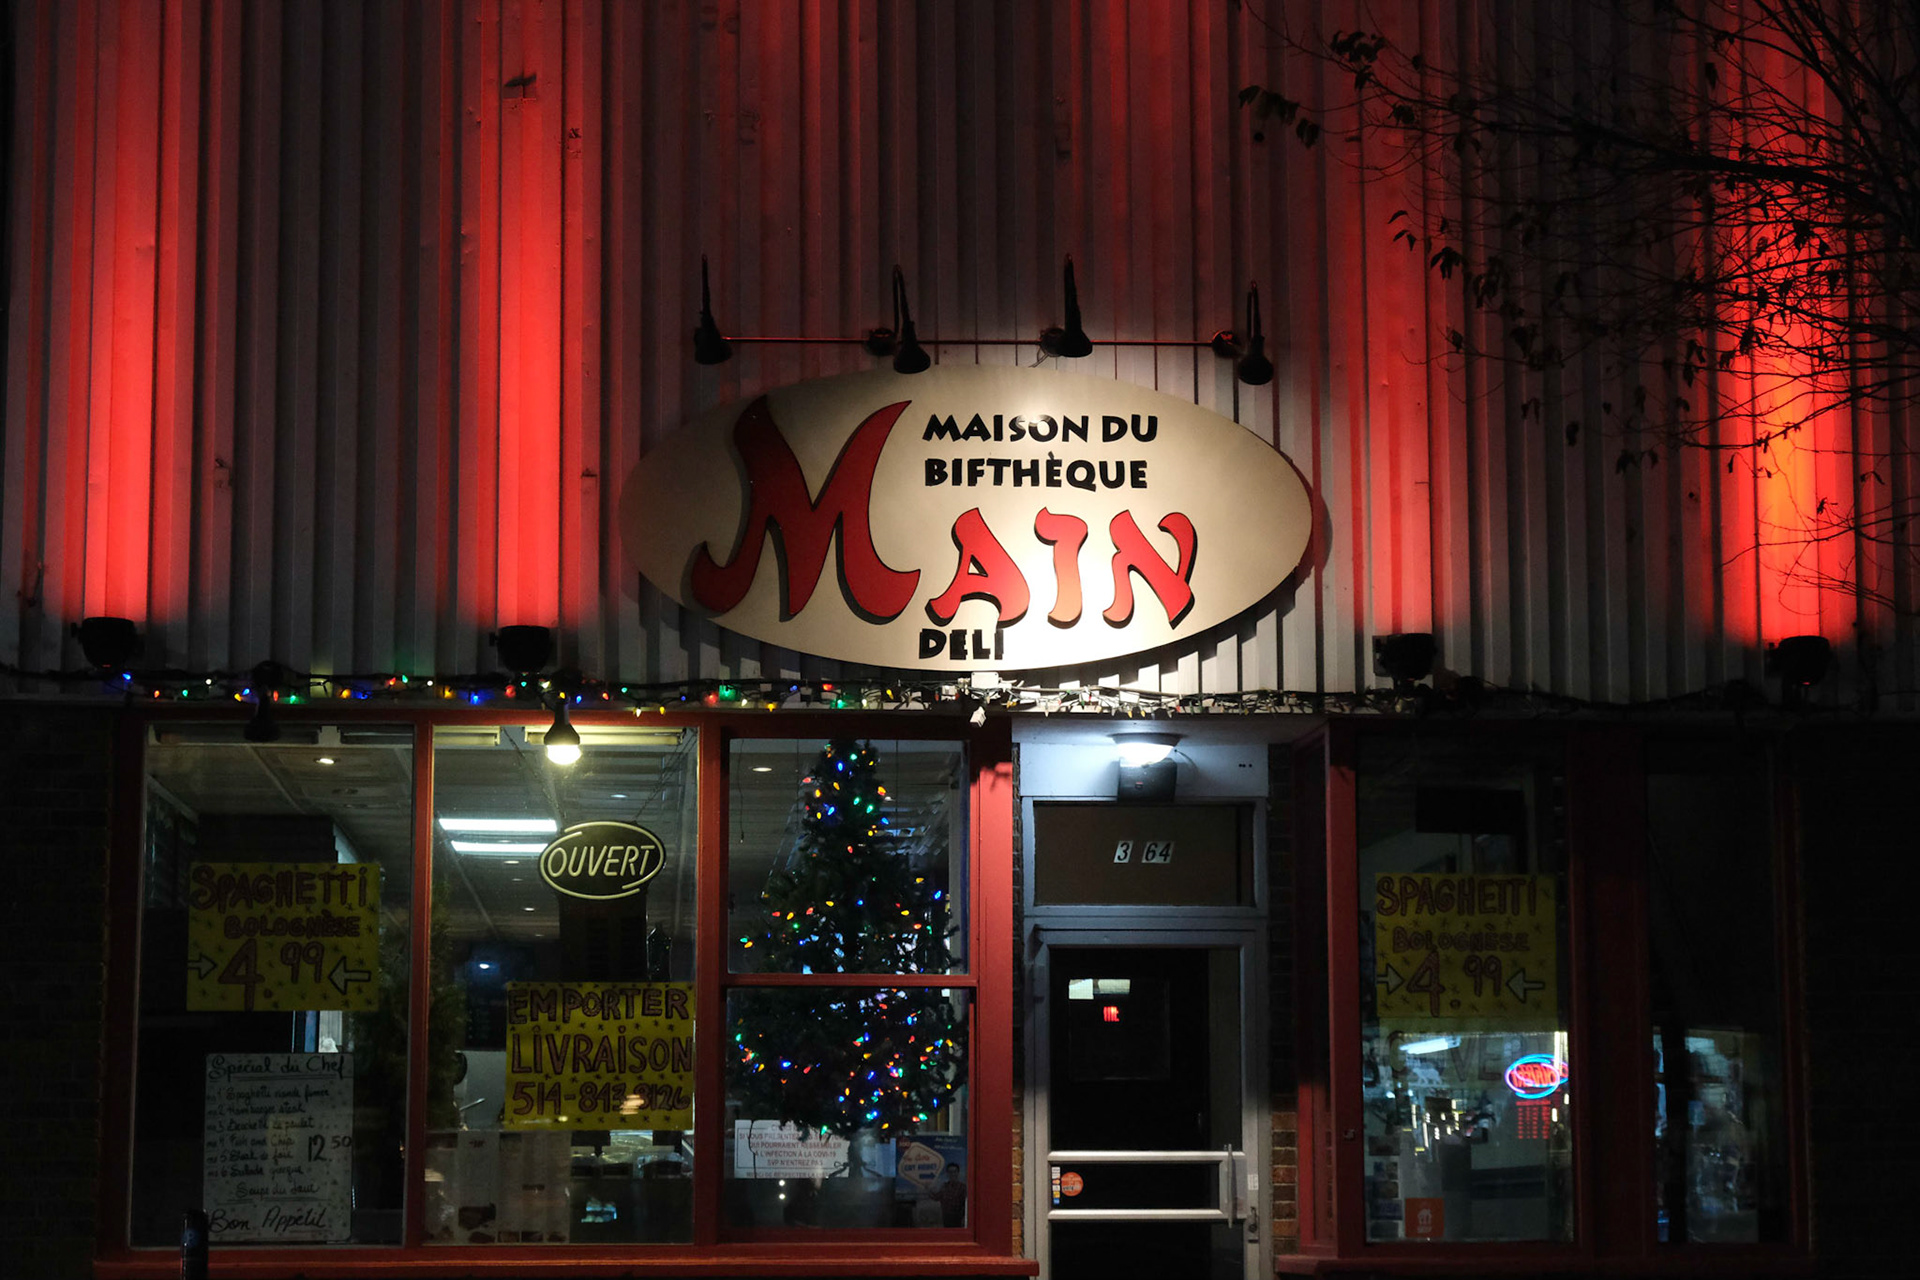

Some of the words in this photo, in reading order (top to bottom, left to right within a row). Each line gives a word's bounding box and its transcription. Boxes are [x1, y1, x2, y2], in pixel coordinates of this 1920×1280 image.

[922, 413, 1089, 443] MAISON
[1101, 414, 1158, 443] DU
[925, 451, 1148, 492] BIFTHÈQUE
[918, 628, 1003, 661] DELI
[547, 845, 656, 878] OUVERT
[209, 1209, 251, 1233] Bon
